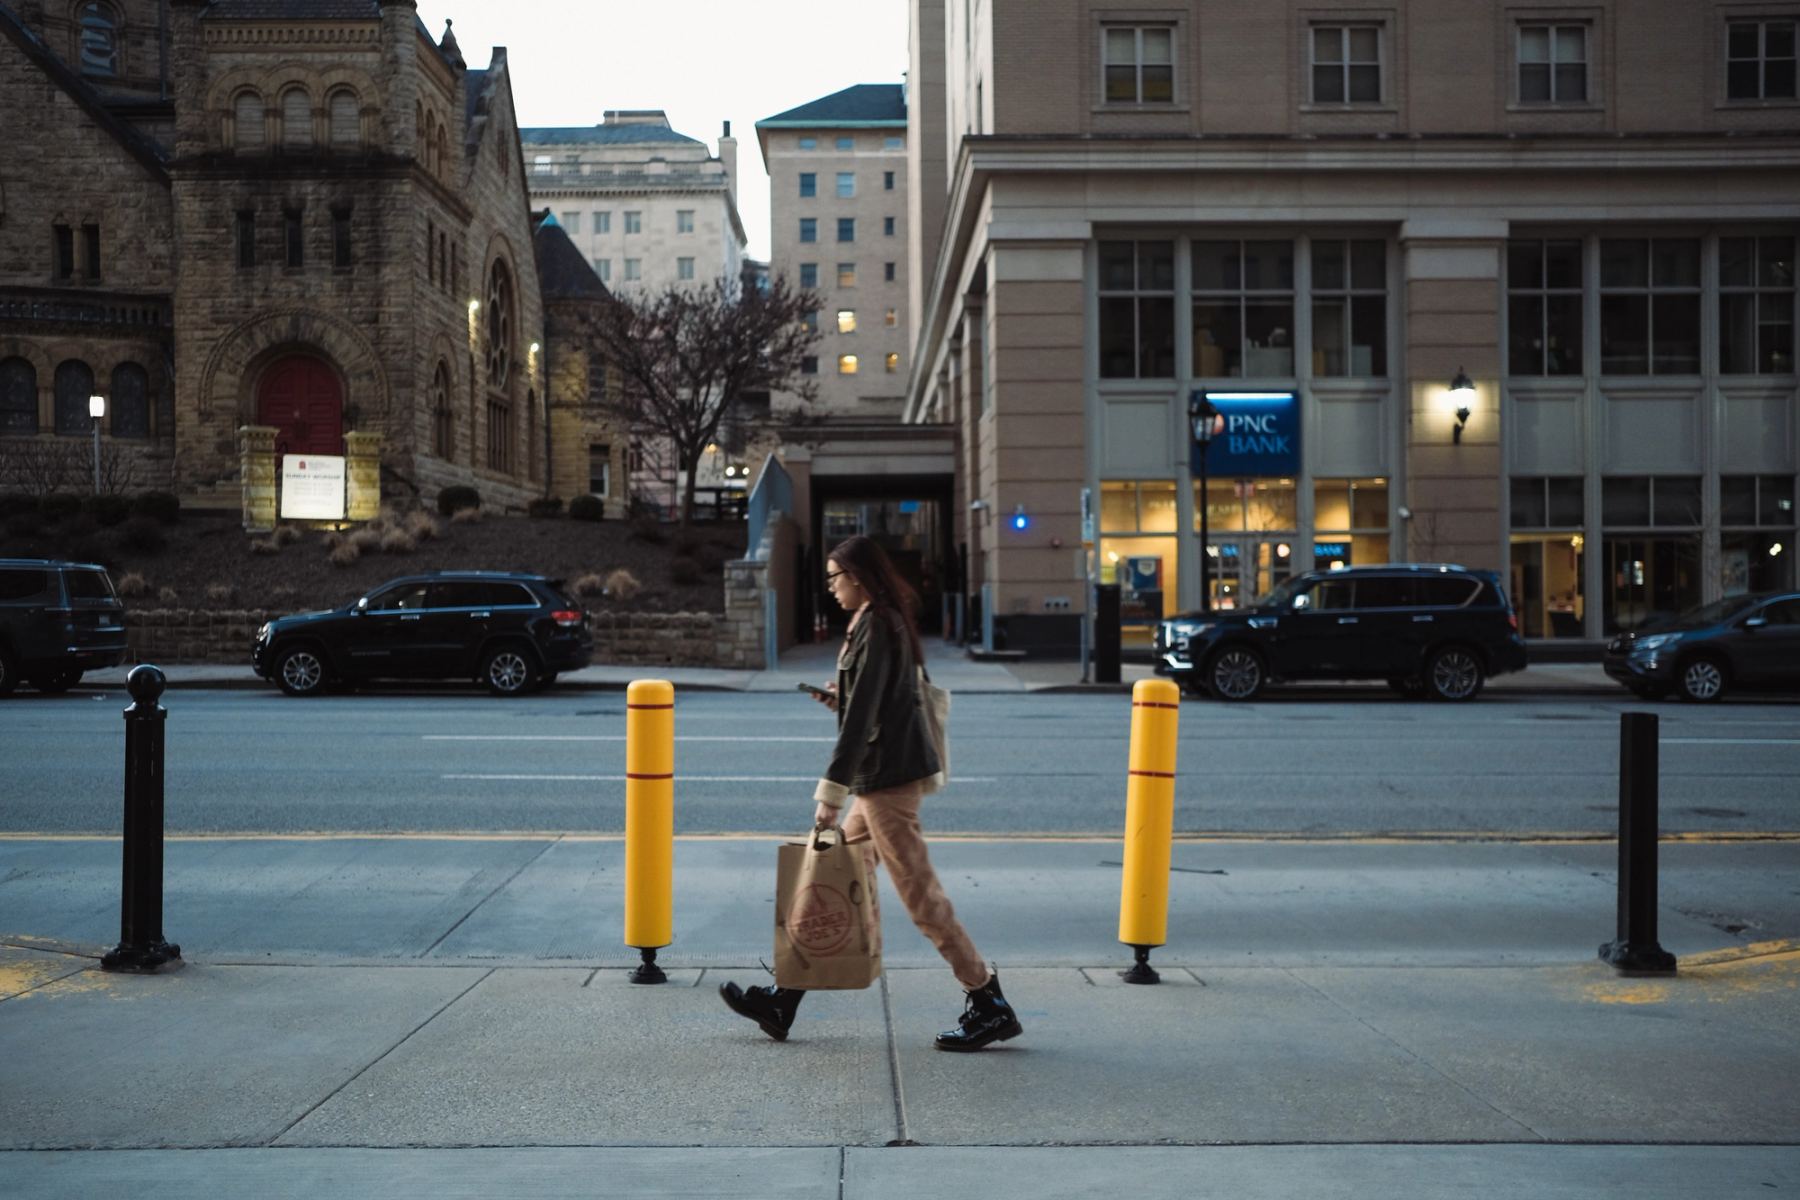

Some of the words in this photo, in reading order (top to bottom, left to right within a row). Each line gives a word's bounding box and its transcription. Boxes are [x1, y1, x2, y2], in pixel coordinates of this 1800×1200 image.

[1229, 415, 1277, 433] PNC
[1229, 435, 1290, 453] BANK
[1314, 544, 1344, 556] BANK
